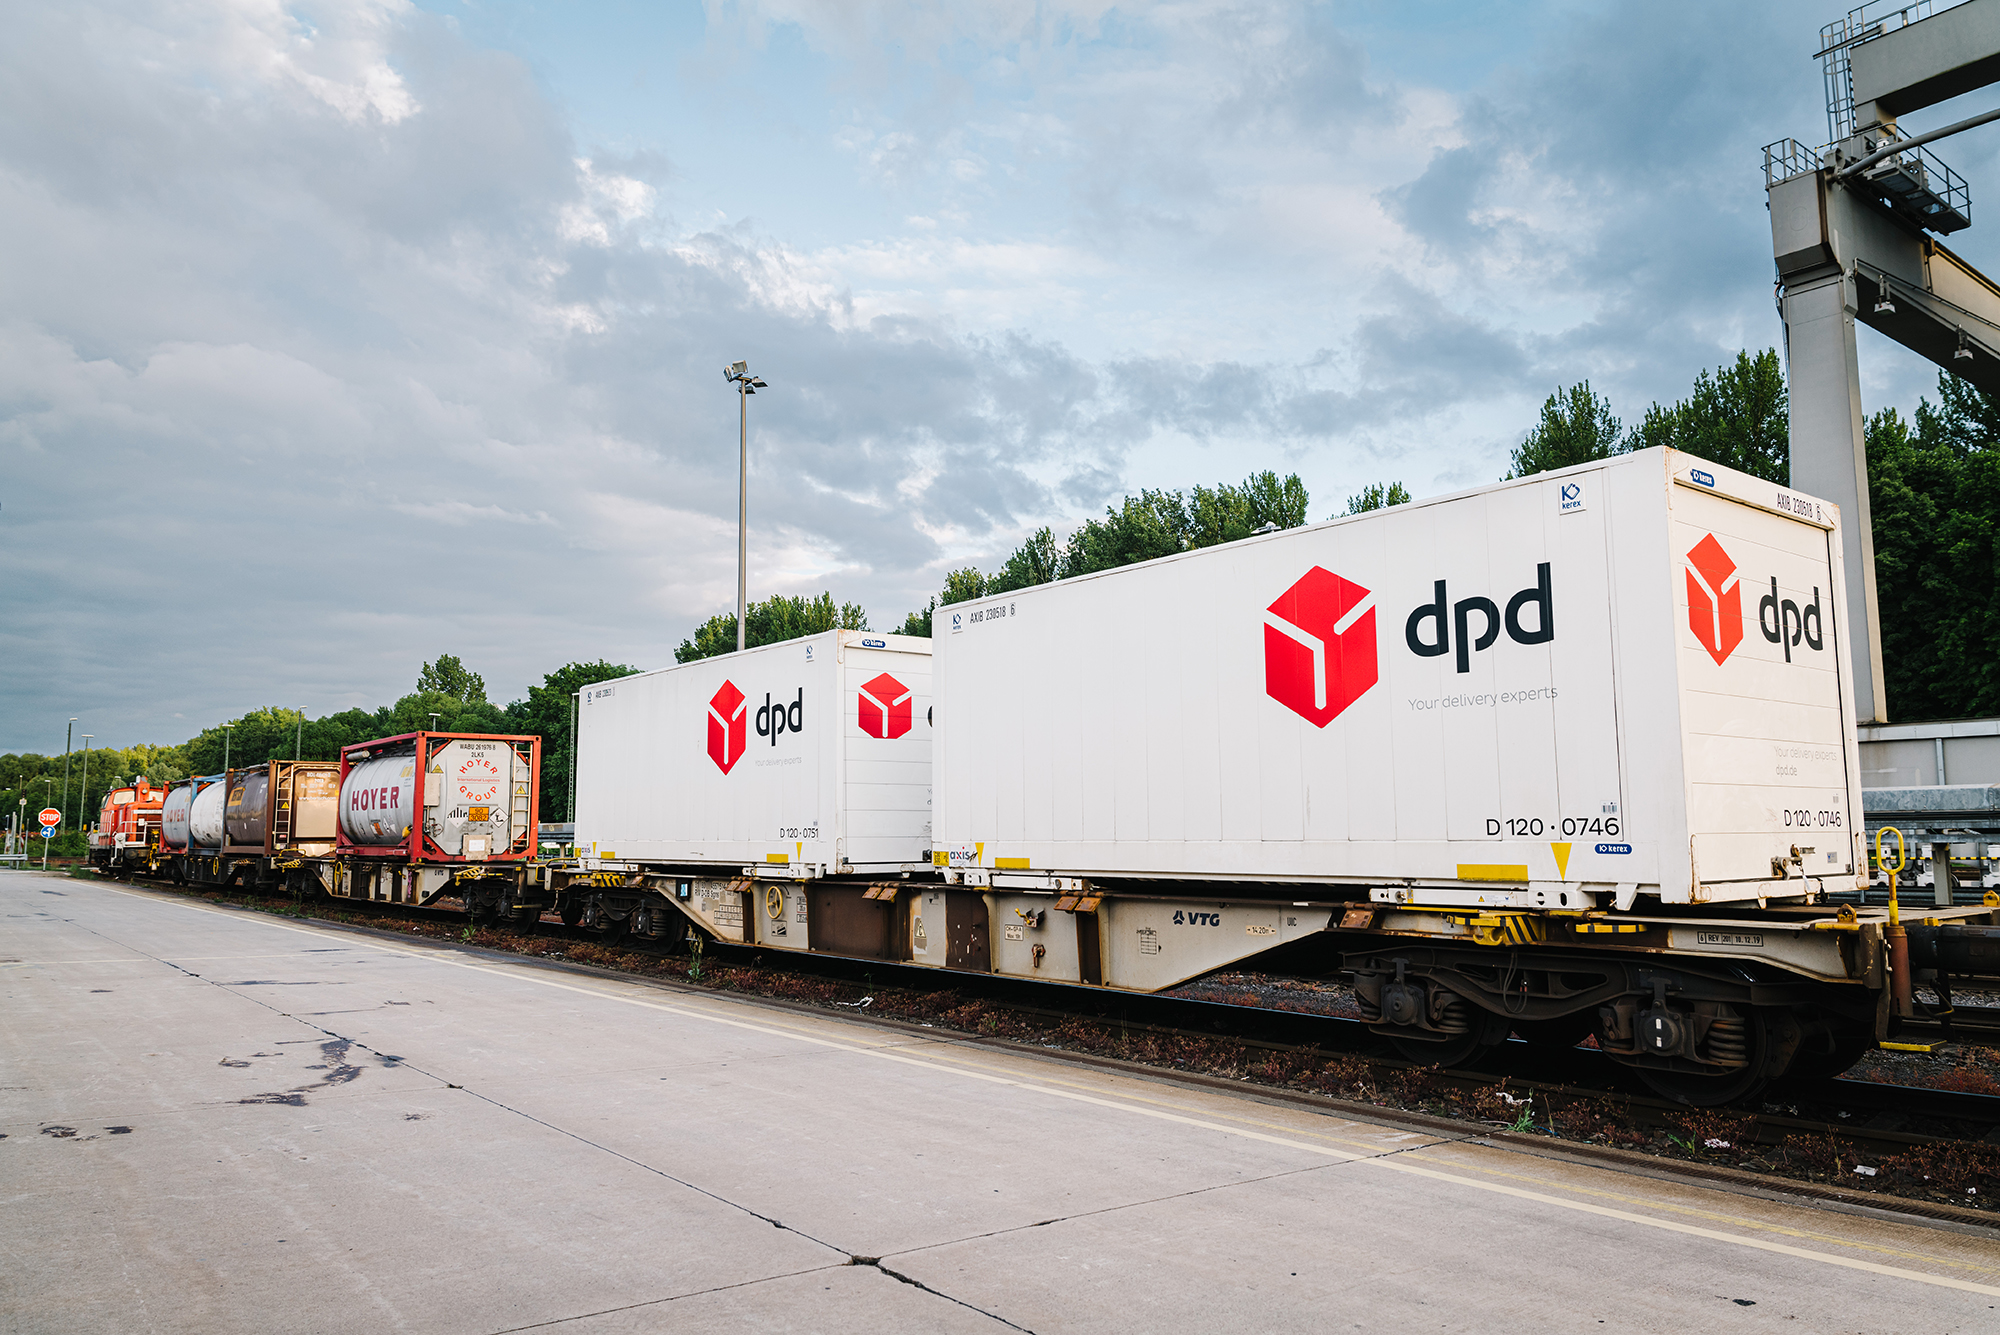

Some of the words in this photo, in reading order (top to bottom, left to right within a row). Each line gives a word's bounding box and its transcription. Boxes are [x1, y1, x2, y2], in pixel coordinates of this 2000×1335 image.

[1562, 500, 1581, 509] kerex
[1777, 493, 1791, 511] AXIB
[970, 610, 984, 624] AXIB
[986, 605, 1006, 621] 230518
[1405, 562, 1555, 674] dpd
[1759, 575, 1824, 663] dpd
[1407, 698, 1440, 711] Your
[1442, 693, 1498, 708] delivery
[1500, 686, 1558, 704] experts
[755, 687, 803, 746] dpd
[1774, 746, 1789, 758] Your
[1790, 747, 1814, 761] delivery
[1815, 749, 1838, 761] experts
[459, 759, 498, 774] HOYER
[1775, 764, 1798, 777] dpd.de
[351, 786, 400, 811] HOYER
[459, 786, 497, 802] GROUP
[166, 809, 185, 823] HOYER
[1784, 809, 1792, 826] D
[1793, 810, 1811, 827] 120
[1818, 810, 1842, 827] 0746
[780, 828, 785, 838] D
[787, 828, 798, 838] 120
[803, 828, 818, 838] 0751
[1486, 818, 1501, 836] D
[1506, 818, 1544, 836] 120
[1562, 818, 1620, 836] 0746
[950, 846, 970, 860] axis
[1608, 844, 1628, 852] kerex
[1188, 912, 1220, 927] VTG
